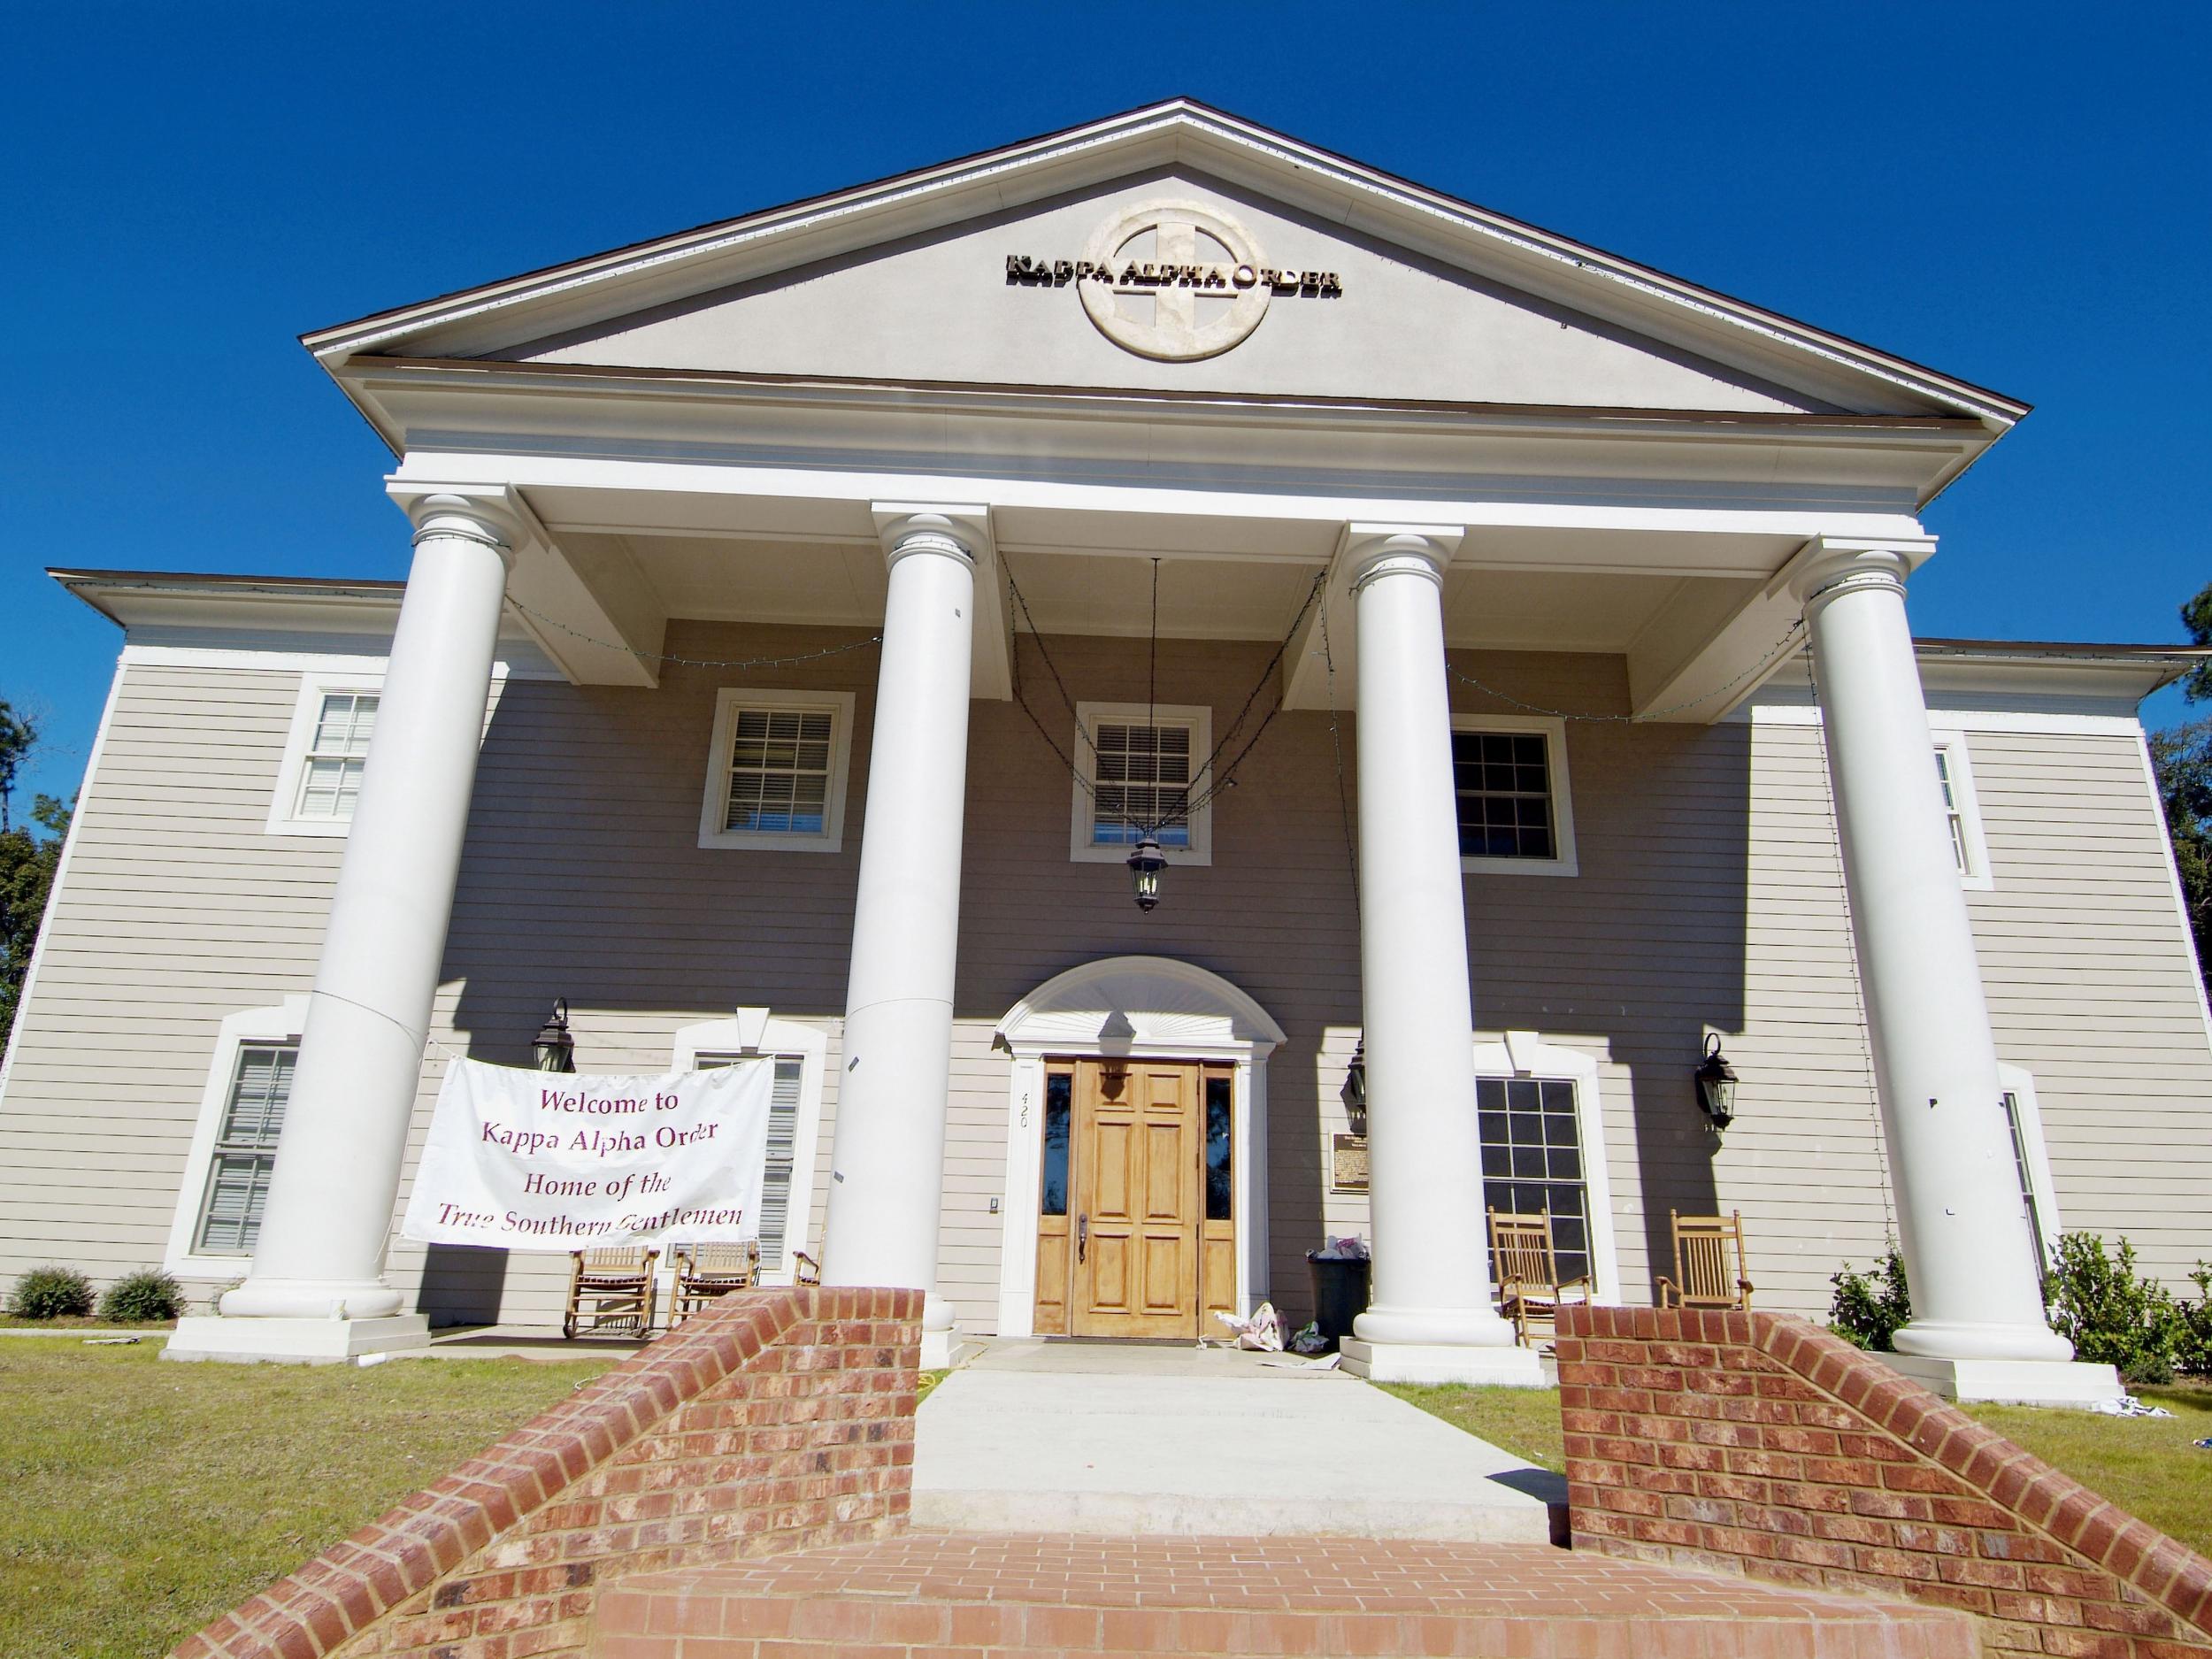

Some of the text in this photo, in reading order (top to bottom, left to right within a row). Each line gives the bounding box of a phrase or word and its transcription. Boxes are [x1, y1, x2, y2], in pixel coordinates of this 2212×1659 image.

[1006, 255, 1341, 293] KAPPA ALPHA ORDER
[541, 1089, 679, 1115] Welcome to
[481, 1121, 718, 1157] Kappa Alpha Order
[524, 1171, 672, 1202] Home of the
[436, 1202, 742, 1236] True Southern Gentlemen
